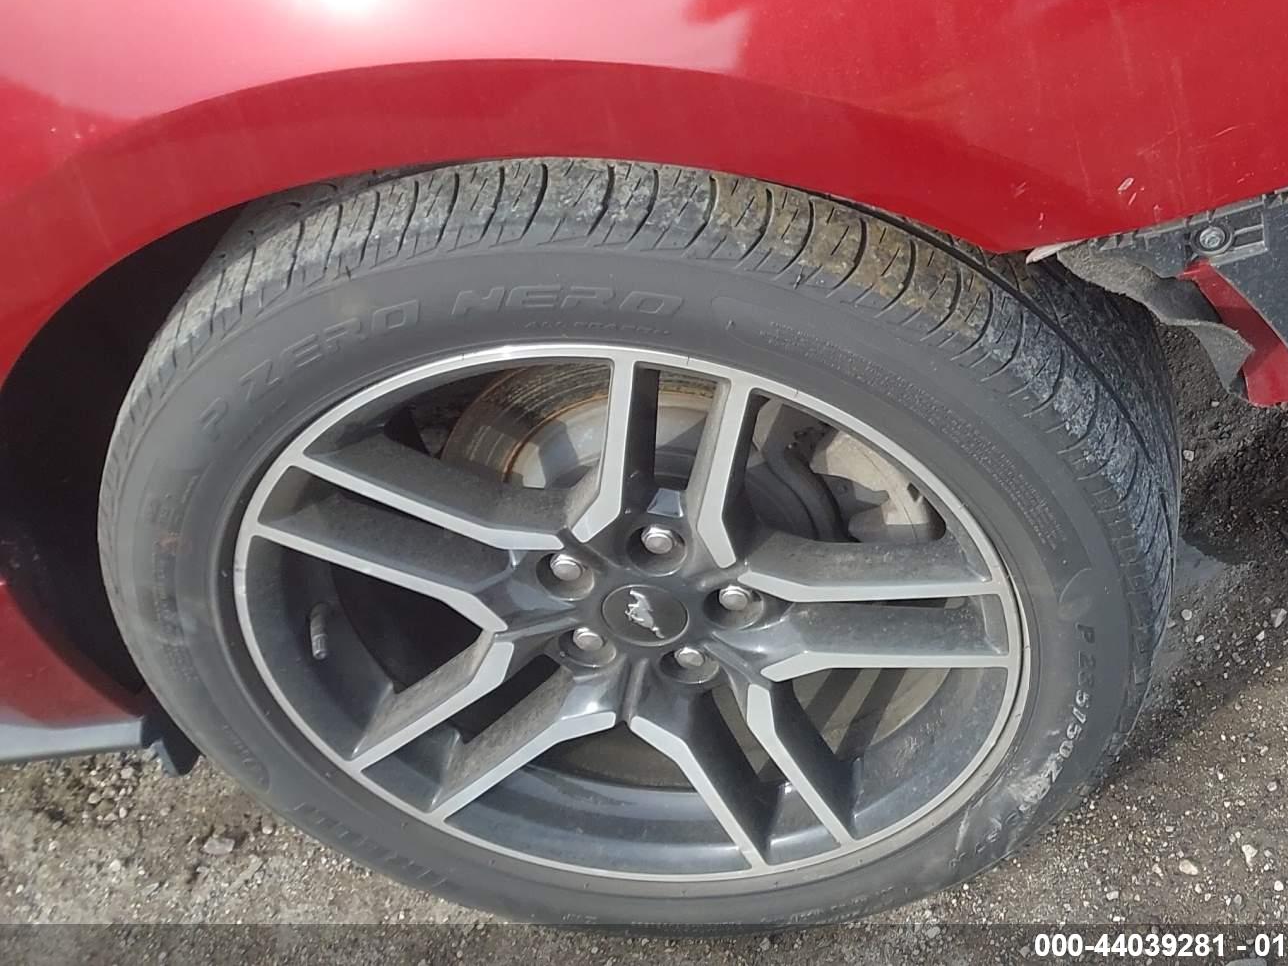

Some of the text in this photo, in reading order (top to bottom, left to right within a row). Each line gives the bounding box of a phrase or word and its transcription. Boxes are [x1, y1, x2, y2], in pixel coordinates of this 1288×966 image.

[196, 396, 230, 443] P
[238, 297, 422, 403] ZERO
[451, 283, 685, 317] NERO
[1074, 621, 1097, 645] P
